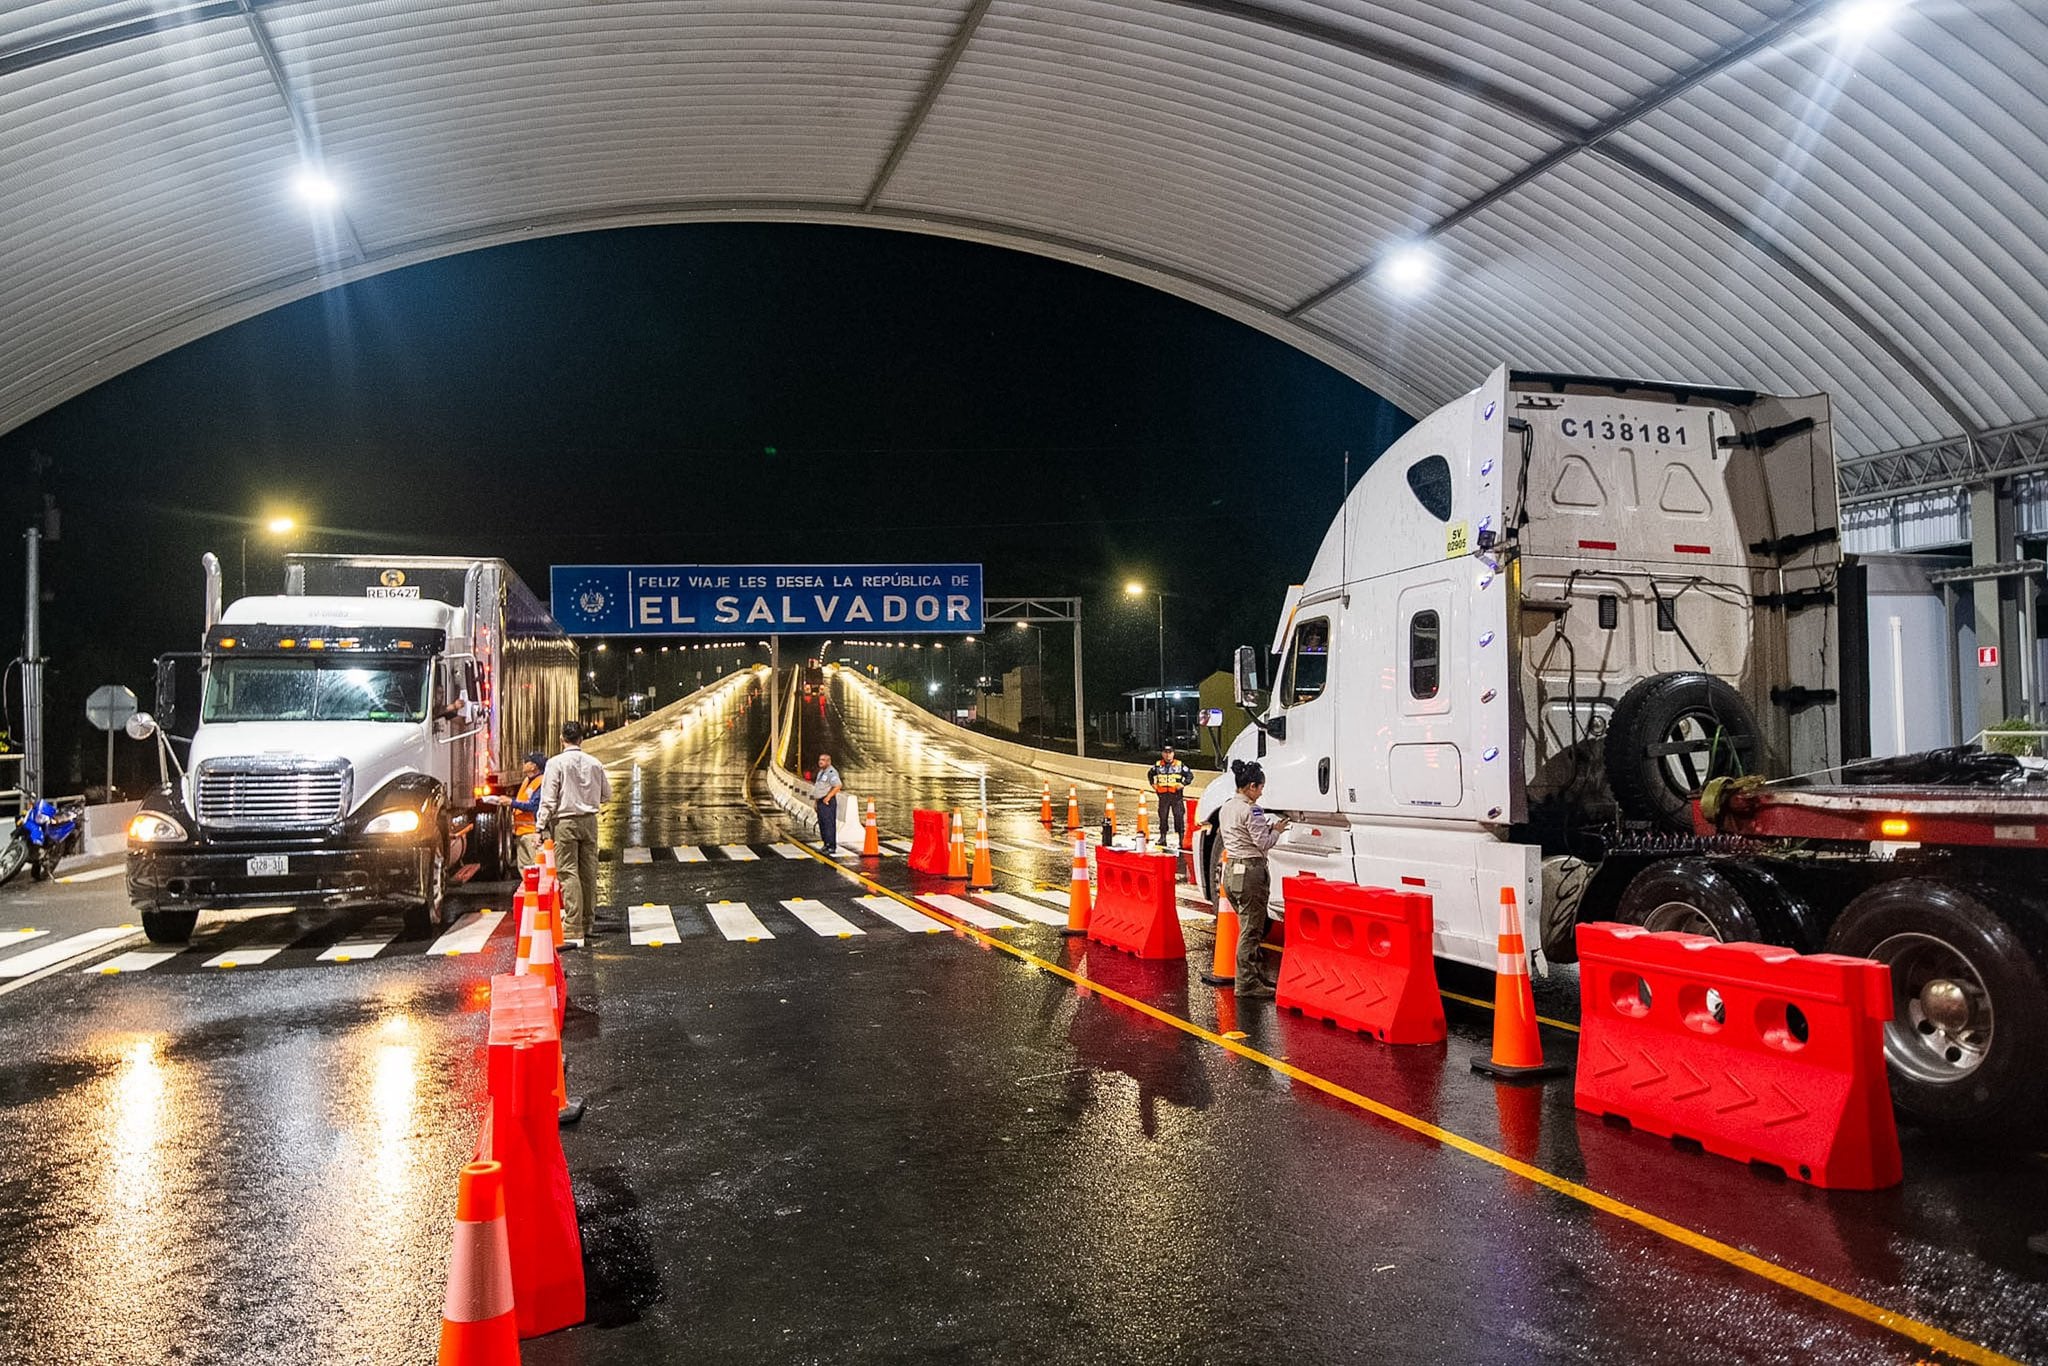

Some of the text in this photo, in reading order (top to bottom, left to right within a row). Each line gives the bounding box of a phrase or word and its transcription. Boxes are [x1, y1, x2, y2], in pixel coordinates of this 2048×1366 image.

[1561, 418, 1686, 445] C138181
[1452, 528, 1463, 540] SV
[1447, 538, 1467, 552] 02905
[639, 573, 968, 587] FELIZ VIAJE LES DESEA LA REPÚBLICA DE
[367, 588, 418, 598] RE16427
[640, 595, 971, 624] EL SALVADOR
